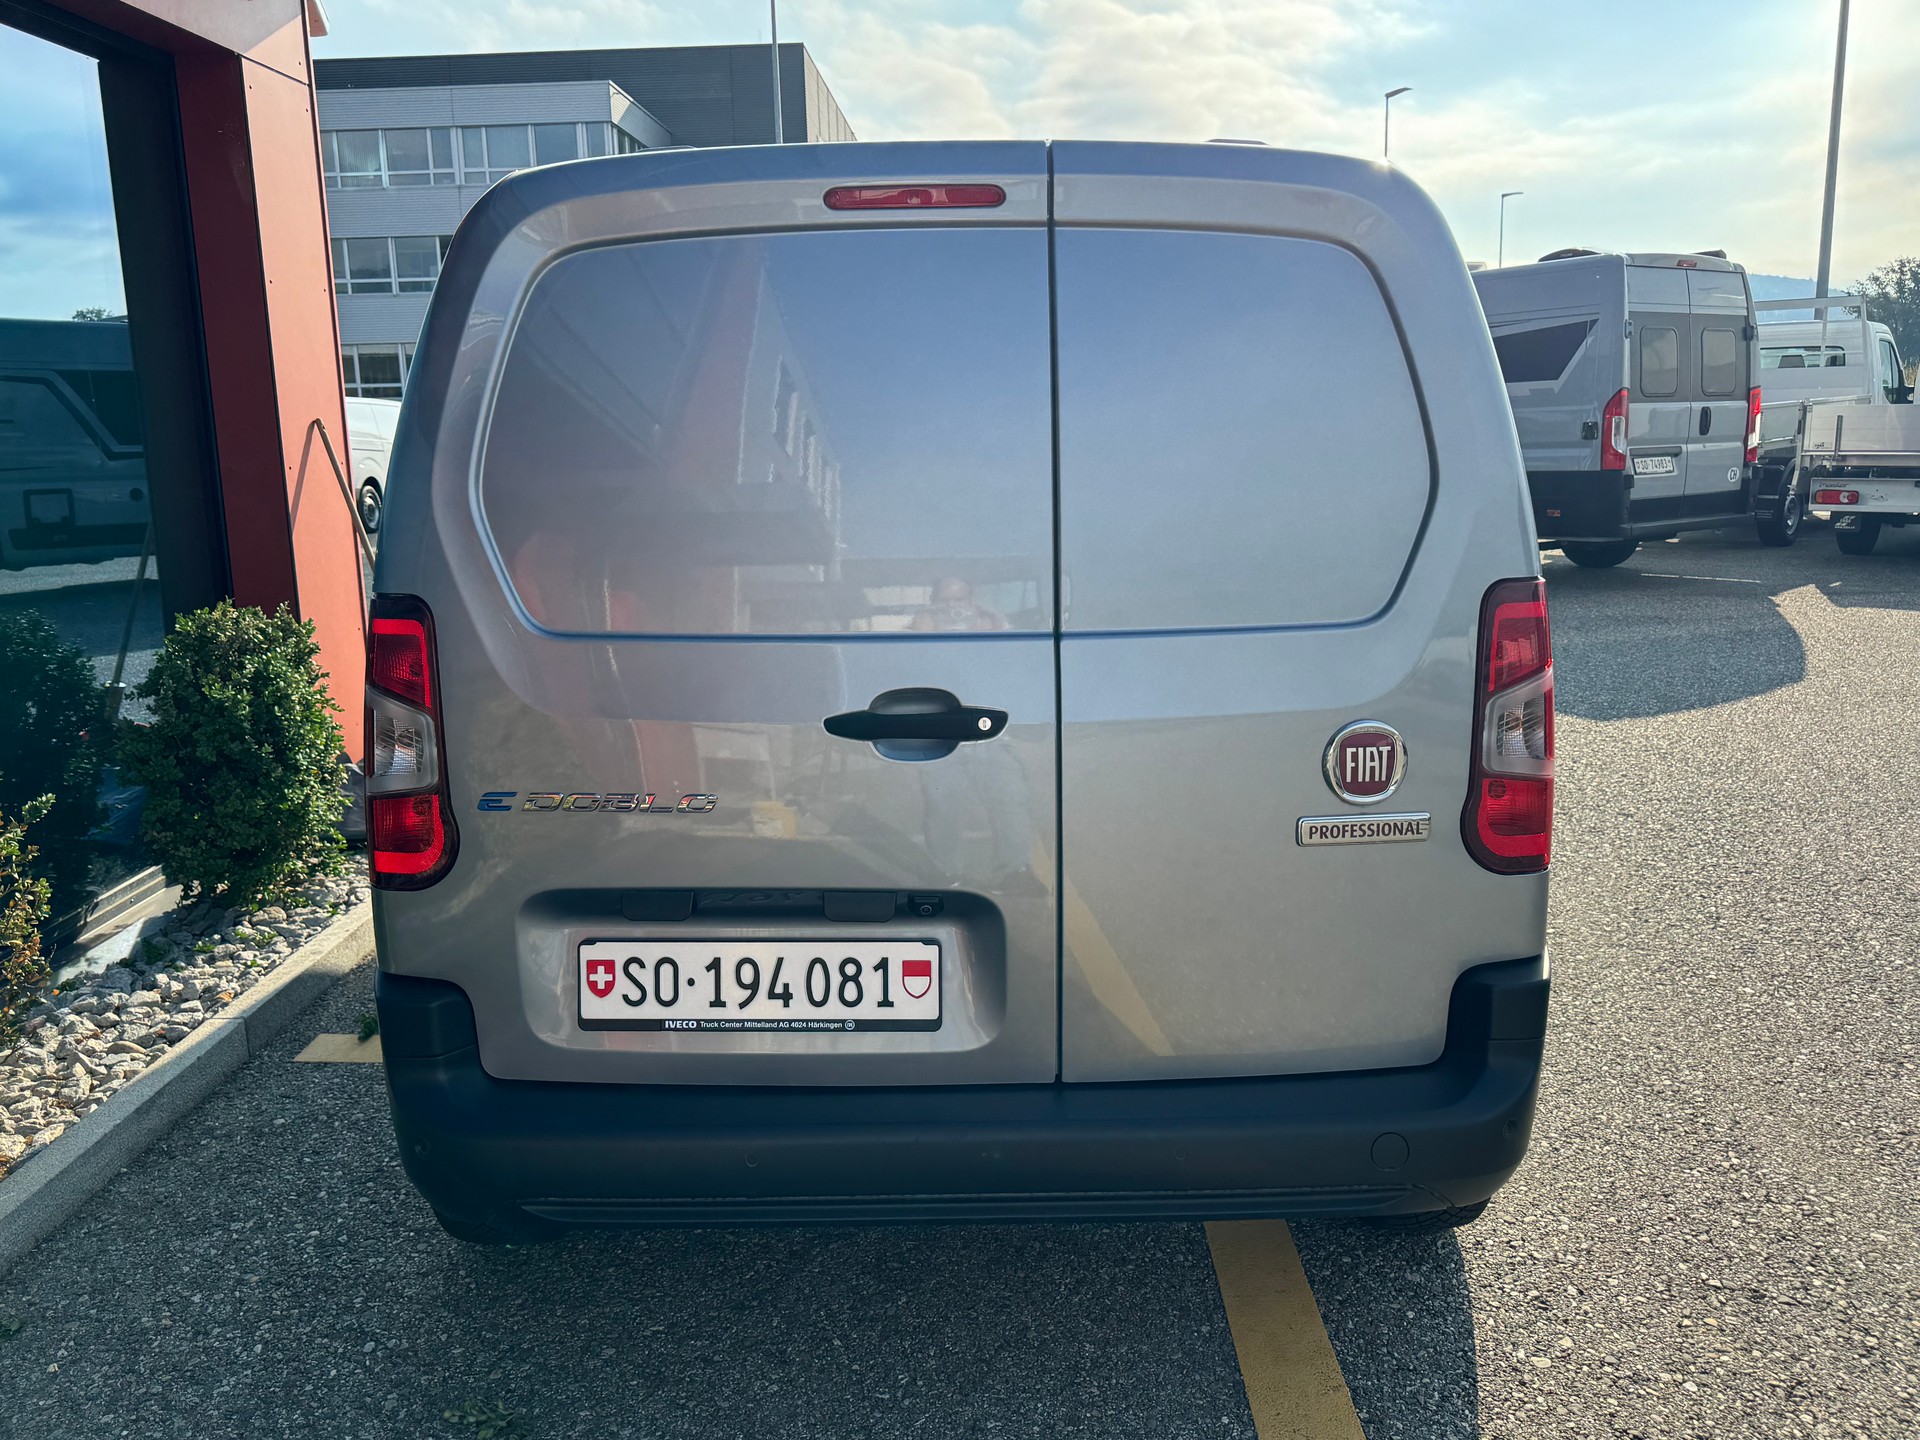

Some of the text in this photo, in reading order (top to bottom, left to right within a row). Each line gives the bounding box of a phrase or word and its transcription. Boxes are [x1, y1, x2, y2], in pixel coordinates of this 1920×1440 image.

[1730, 469, 1737, 480] CH
[1346, 746, 1391, 782] FIAT
[477, 791, 518, 812] E
[1309, 821, 1423, 840] PROFESSIONAL
[664, 1020, 697, 1029] IVECO
[700, 1020, 719, 1029] Truck
[721, 1020, 743, 1029] Center
[744, 1020, 777, 1029] Mittelland
[779, 1020, 790, 1029] AG
[791, 1020, 807, 1029] 4624
[808, 1020, 842, 1031] Härkingen
